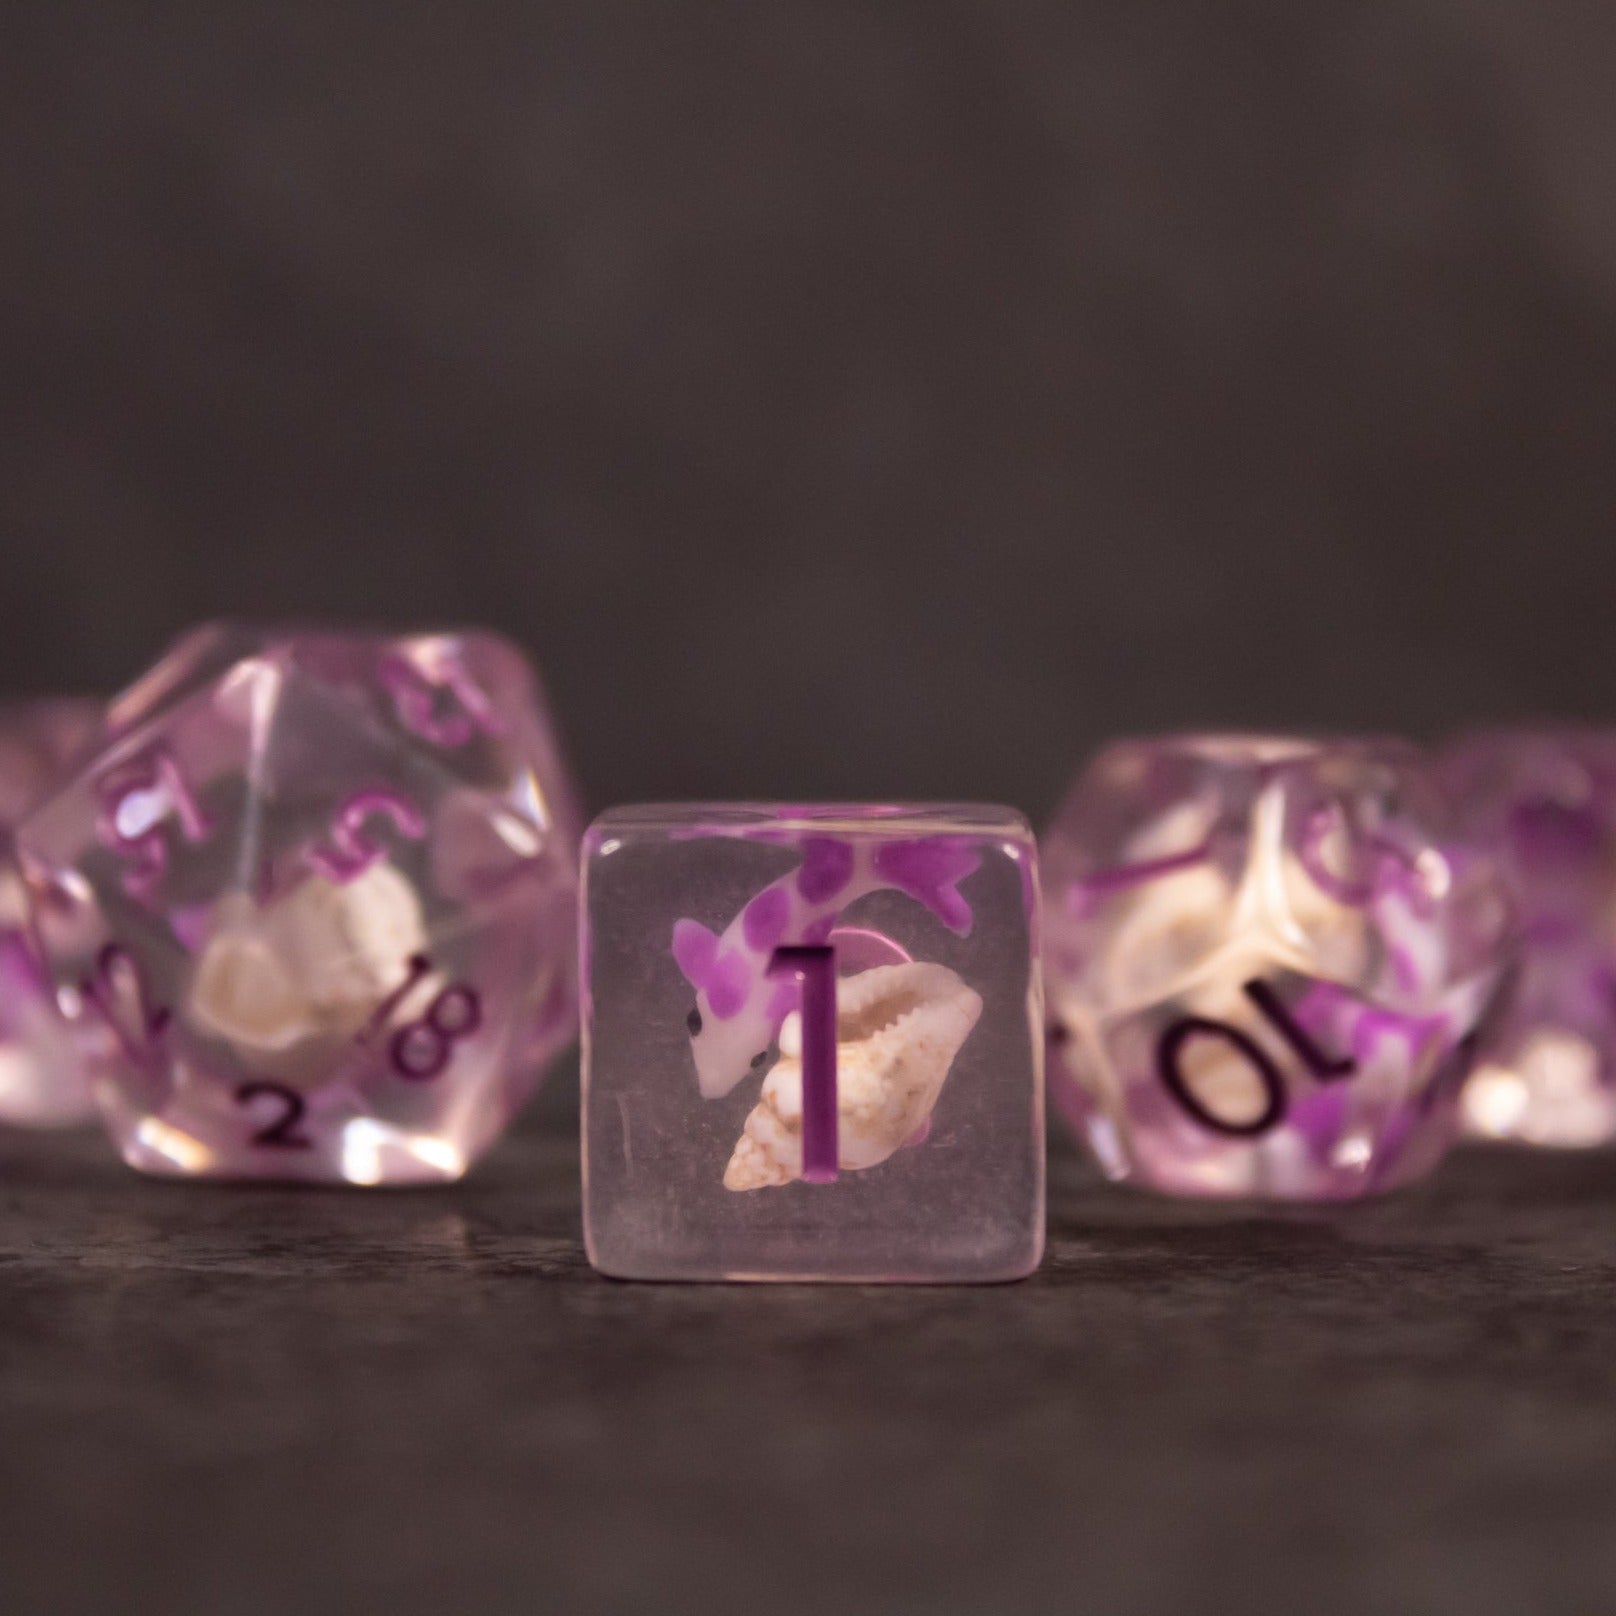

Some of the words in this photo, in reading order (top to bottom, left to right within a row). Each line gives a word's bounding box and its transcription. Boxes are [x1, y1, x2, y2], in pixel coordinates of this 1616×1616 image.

[234, 1081, 309, 1151] 2
[765, 944, 839, 1184] 1
[1157, 977, 1358, 1138] 10
